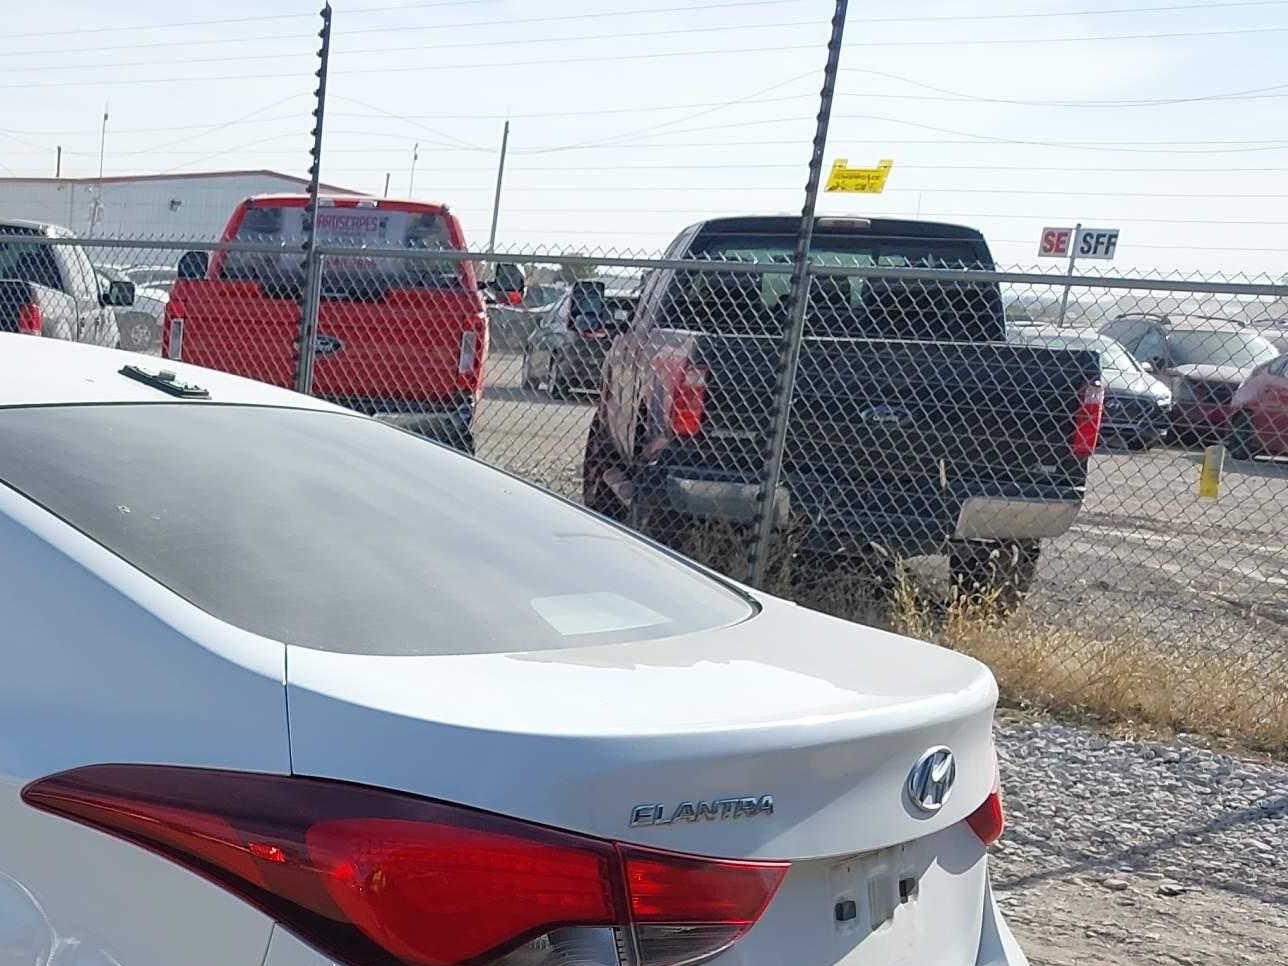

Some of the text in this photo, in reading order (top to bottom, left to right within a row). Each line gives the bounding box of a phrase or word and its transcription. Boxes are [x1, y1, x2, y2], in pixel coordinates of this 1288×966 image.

[318, 214, 378, 232] ARDSCAPES
[1042, 230, 1069, 253] SE
[1080, 232, 1118, 255] SFF
[630, 794, 774, 828] ELANTRA
